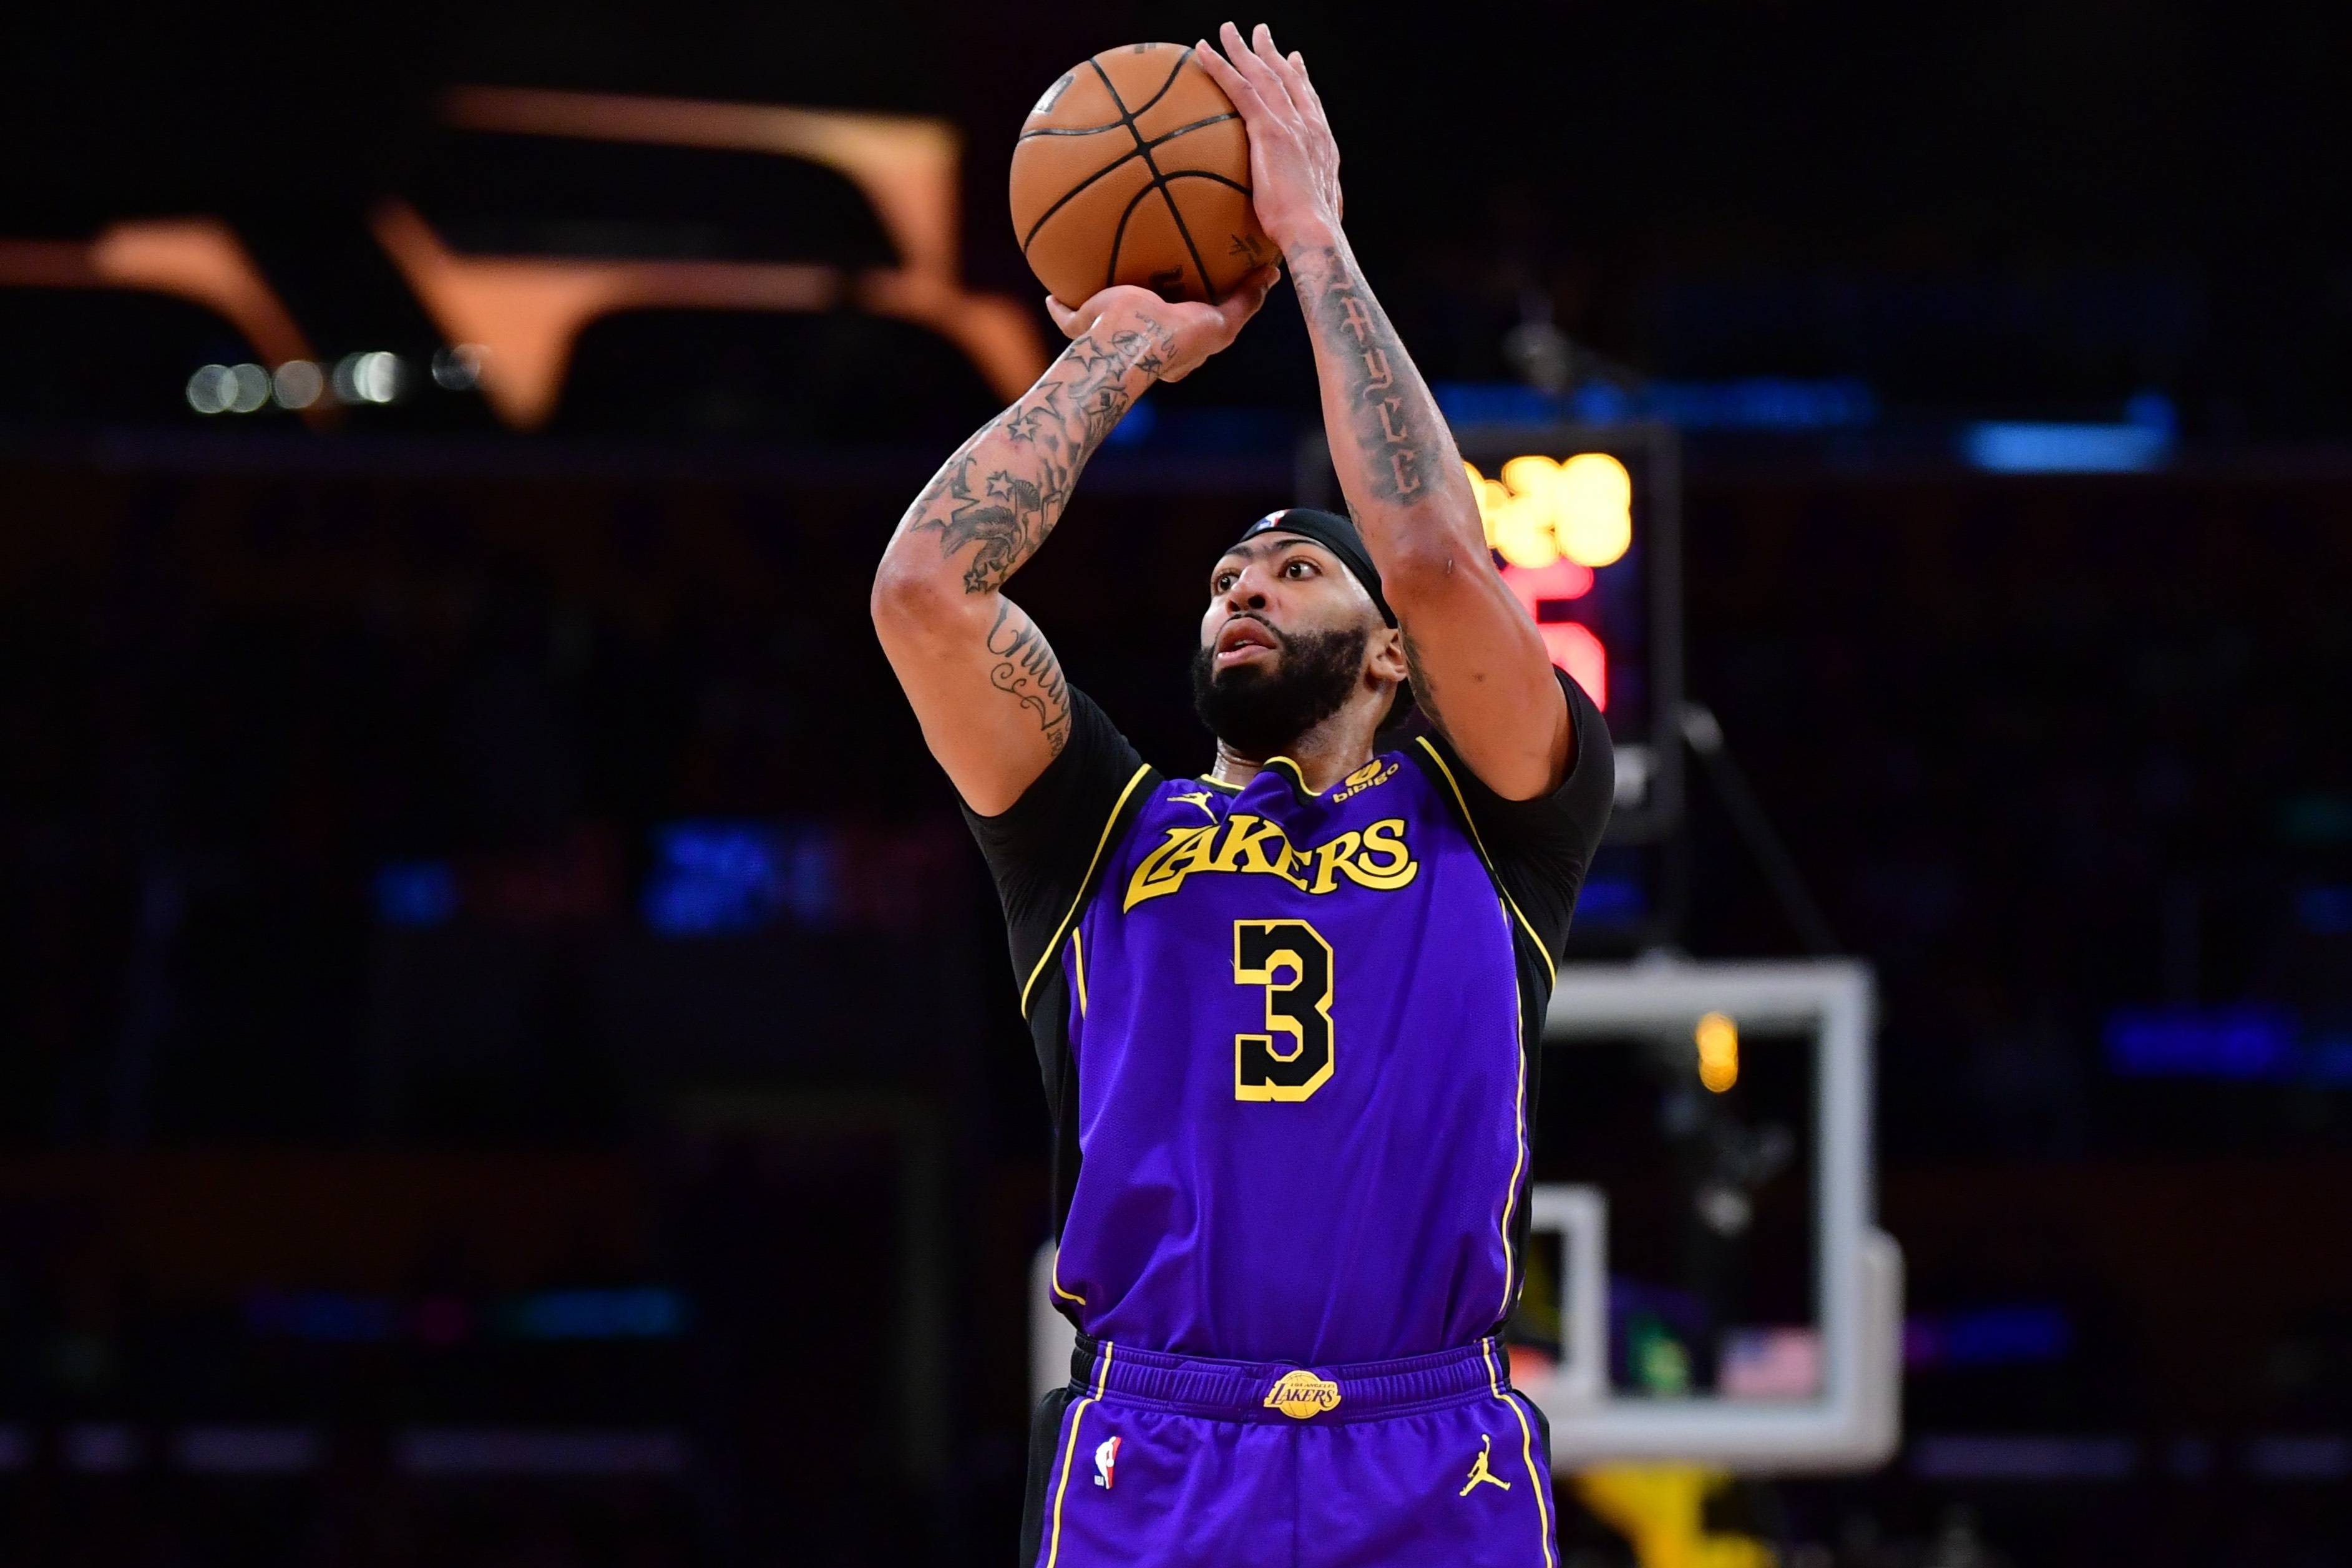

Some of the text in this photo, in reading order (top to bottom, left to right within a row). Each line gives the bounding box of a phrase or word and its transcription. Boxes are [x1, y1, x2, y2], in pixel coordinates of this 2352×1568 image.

[1332, 762, 1399, 804] bibigo
[1123, 814, 1420, 915] LAKERS
[1234, 919, 1335, 1102] 3
[1266, 1383, 1339, 1408] LAKERS
